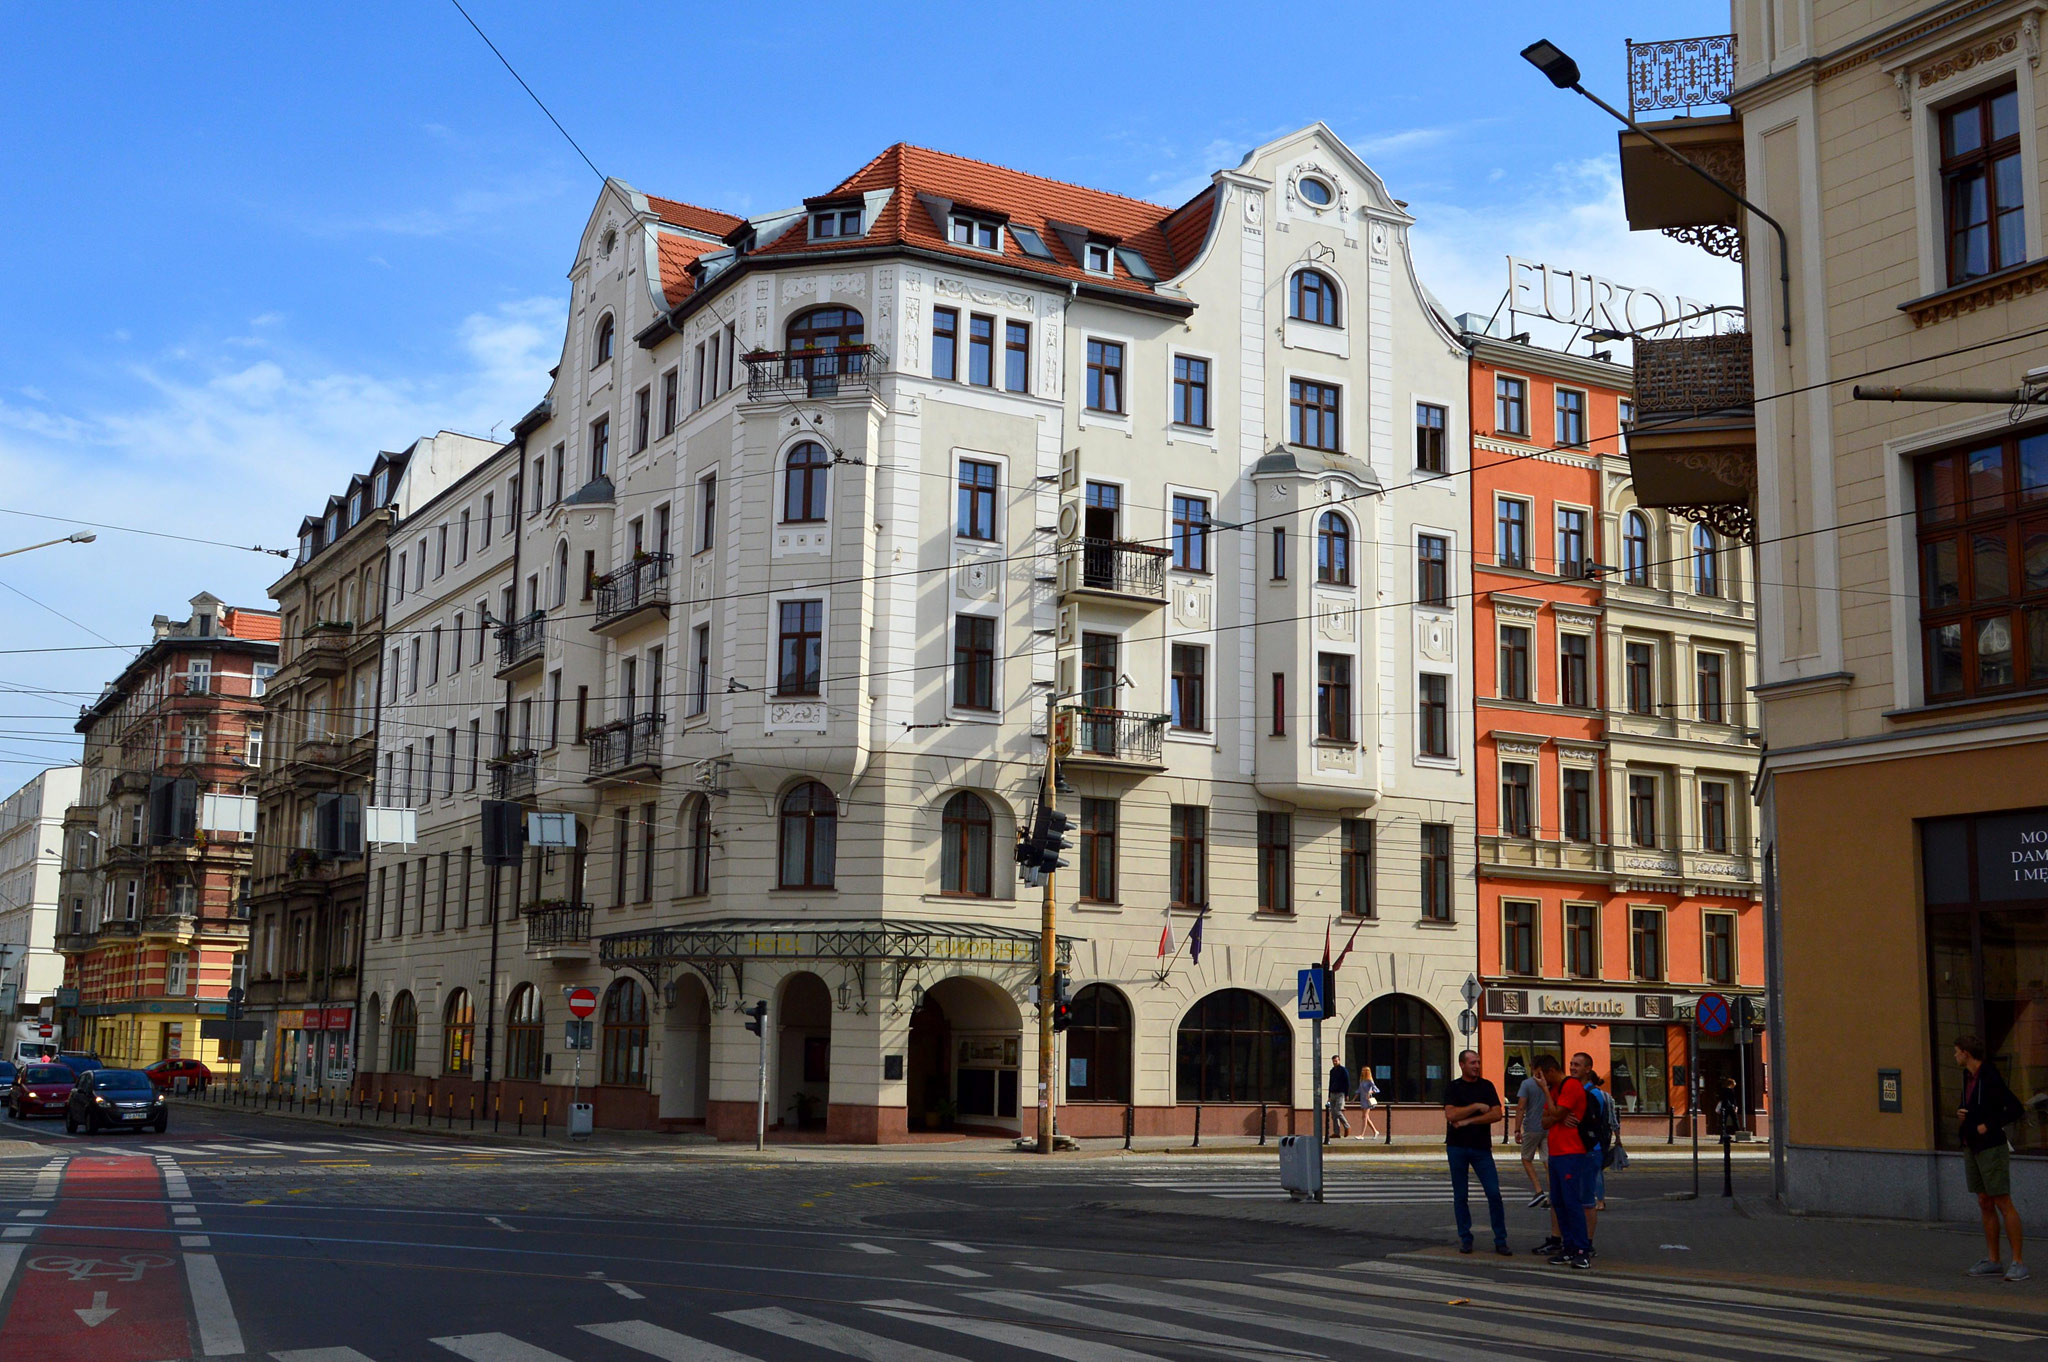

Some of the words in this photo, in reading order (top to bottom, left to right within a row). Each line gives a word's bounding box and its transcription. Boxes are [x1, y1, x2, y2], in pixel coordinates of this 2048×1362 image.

[1056, 448, 1079, 696] HOTEL
[2021, 830, 2048, 844] MO
[2010, 849, 2048, 864] DAM
[2014, 869, 2020, 882] I
[747, 936, 806, 953] HOTEL
[934, 940, 1030, 959] EUROPEJSKI
[1542, 994, 1626, 1015] Kawiarnia
